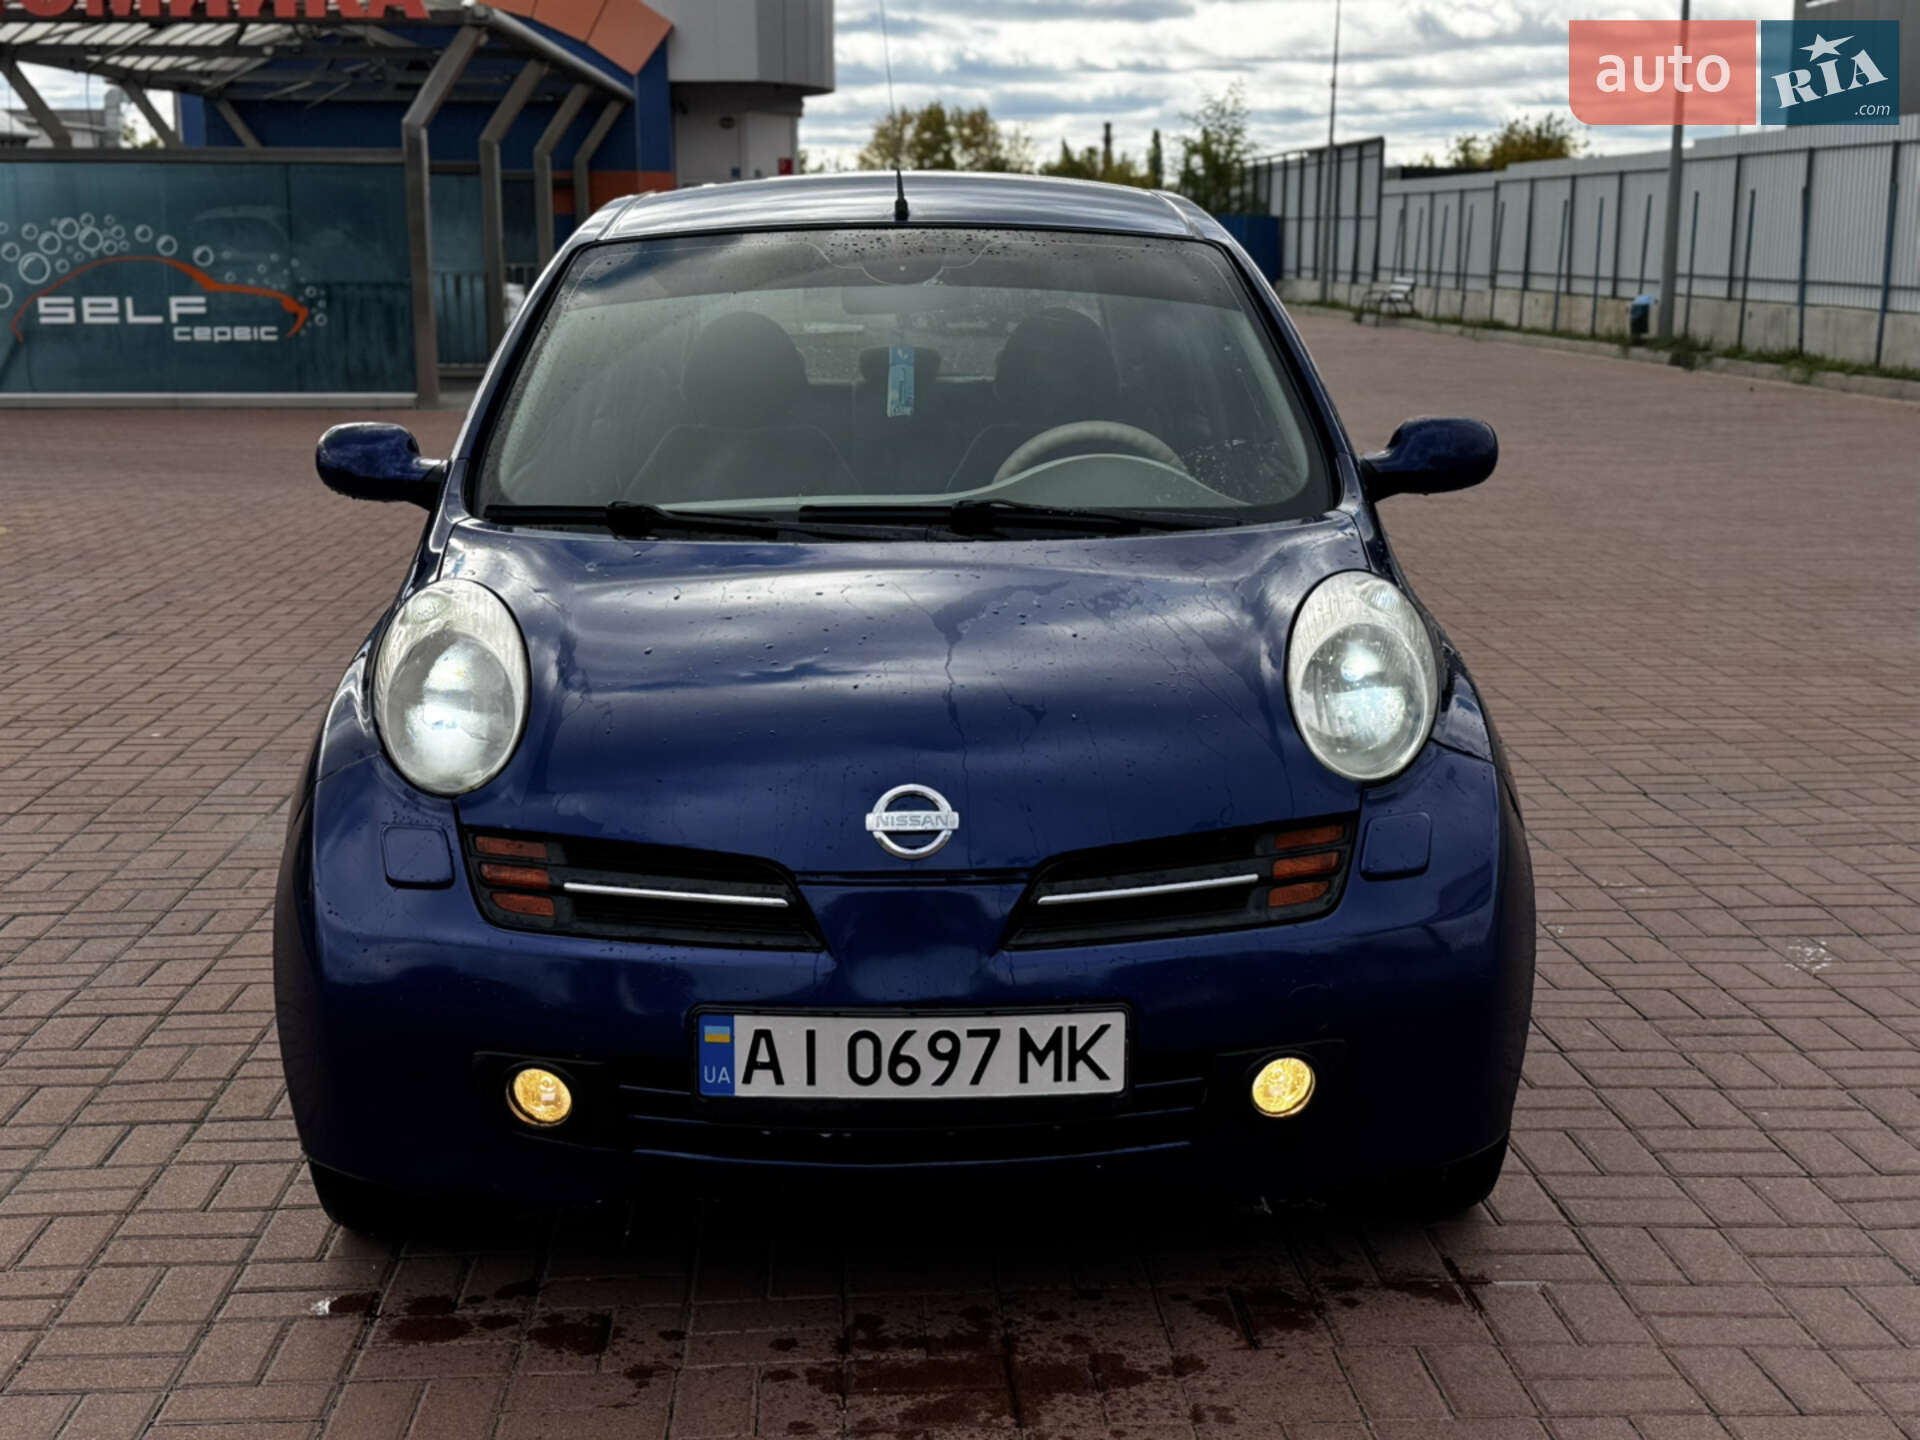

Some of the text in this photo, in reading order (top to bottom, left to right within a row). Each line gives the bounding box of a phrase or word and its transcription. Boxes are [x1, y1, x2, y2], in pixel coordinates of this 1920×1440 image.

[875, 815, 949, 828] NISSAN
[742, 1024, 1111, 1086] AI 0697 MK
[704, 1066, 730, 1084] UA
